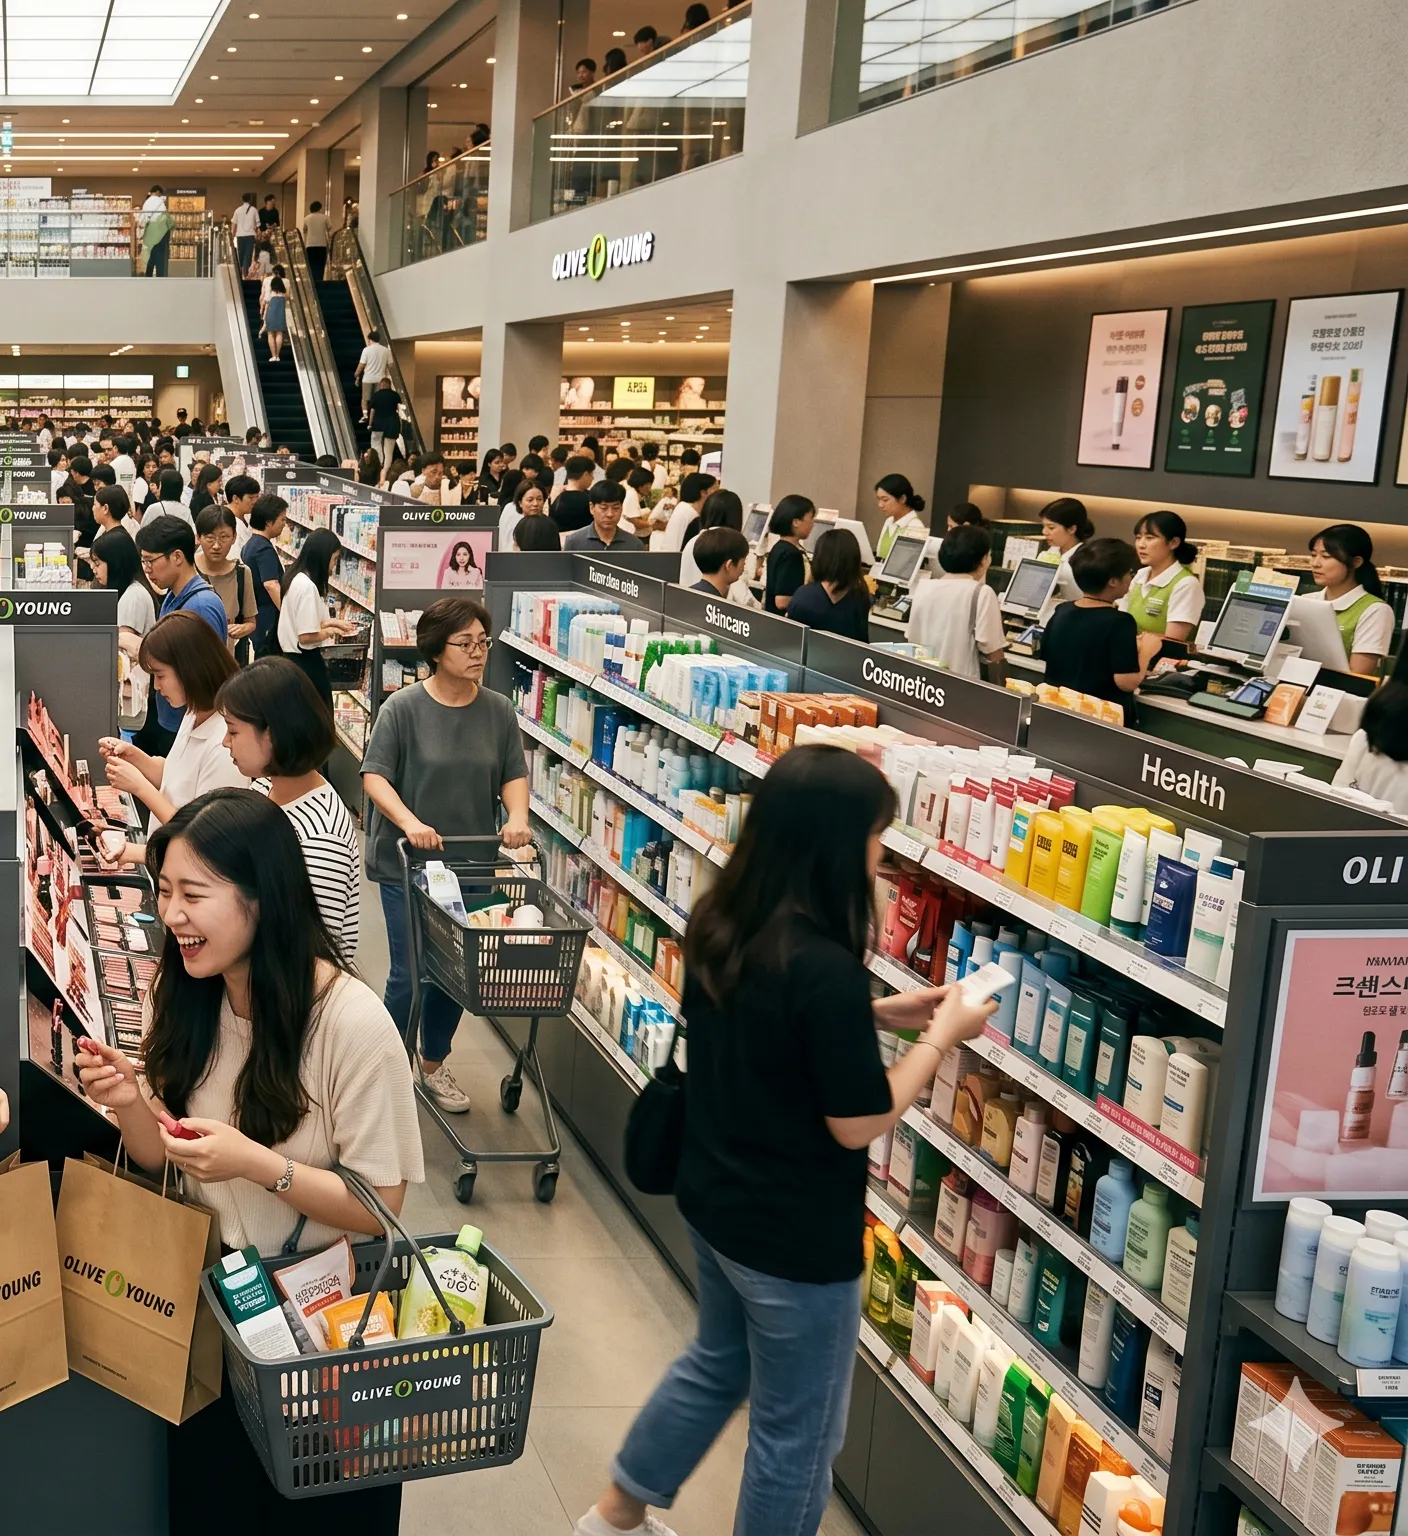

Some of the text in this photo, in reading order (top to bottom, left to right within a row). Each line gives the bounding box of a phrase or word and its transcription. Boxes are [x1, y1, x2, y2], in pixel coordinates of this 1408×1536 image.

[552, 231, 655, 281] OLIVE YOUNG
[13, 511, 47, 520] YOUNG
[402, 512, 431, 521] OLIVE
[14, 601, 72, 616] YOUNG
[705, 603, 751, 638] Skincare
[861, 657, 946, 709] Cosmetics
[1140, 753, 1227, 812] Health
[1342, 856, 1405, 885] OLI
[63, 1255, 176, 1319] OLIVE YOUNG
[351, 1374, 462, 1403] OLIVE YOUNG
